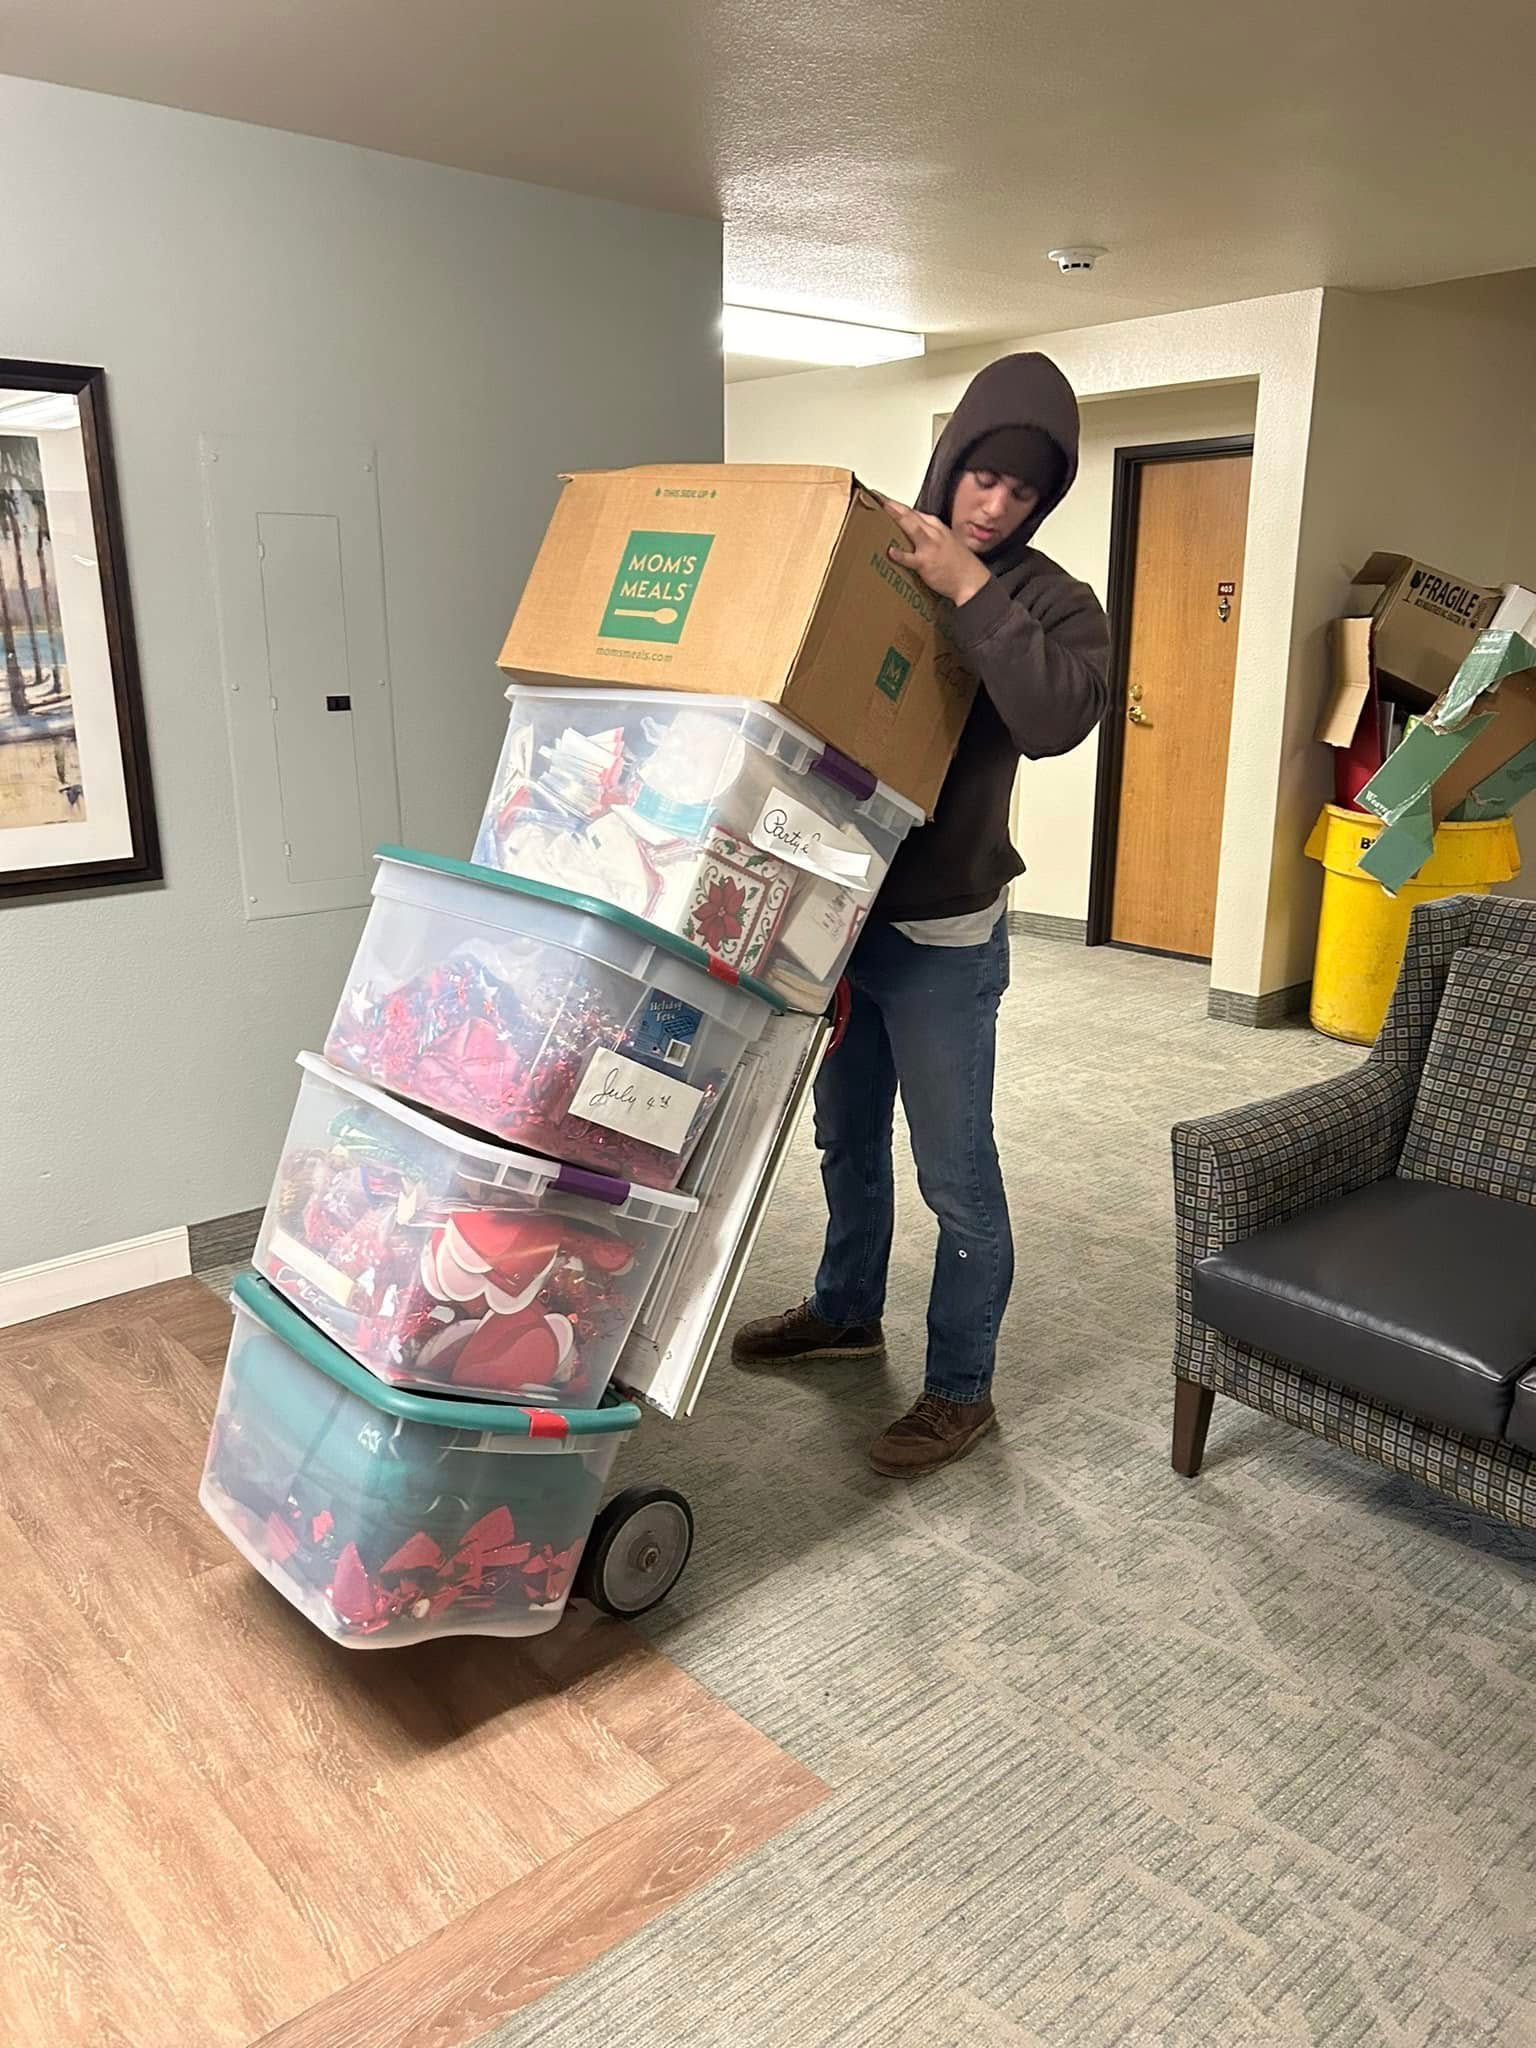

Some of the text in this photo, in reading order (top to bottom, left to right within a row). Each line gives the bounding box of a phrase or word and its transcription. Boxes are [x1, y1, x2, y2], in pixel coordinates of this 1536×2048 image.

[628, 553, 698, 575] MOM'S
[619, 580, 687, 601] MEALS
[1418, 572, 1481, 619] FRAGILE
[596, 646, 674, 662] momsmeals.com
[762, 808, 801, 855] Party
[589, 1067, 637, 1112] July
